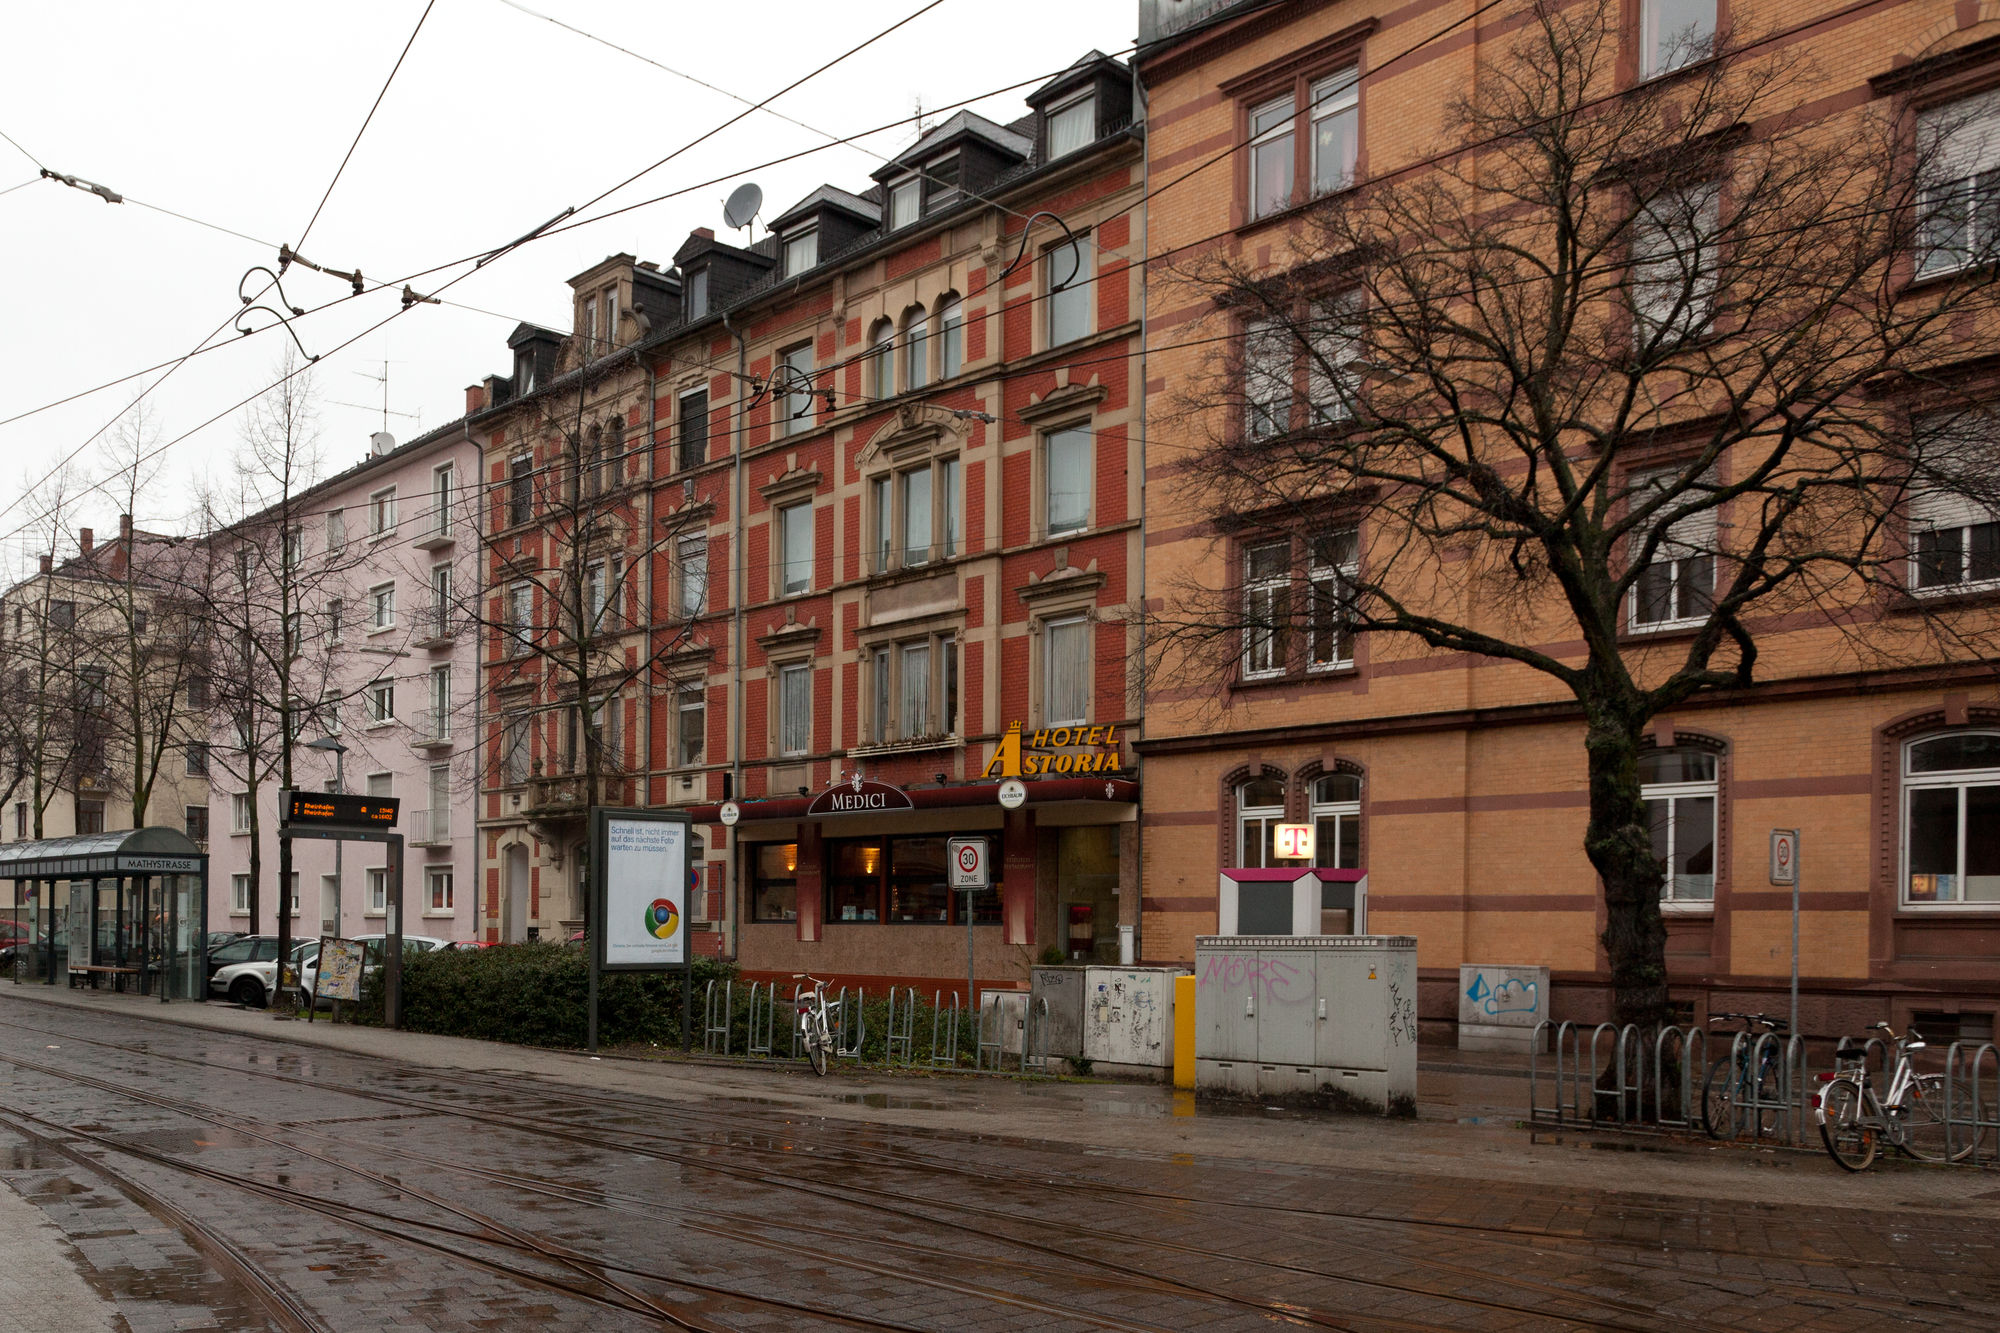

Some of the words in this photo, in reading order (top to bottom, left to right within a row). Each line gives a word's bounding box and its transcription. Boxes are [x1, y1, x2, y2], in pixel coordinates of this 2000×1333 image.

[1032, 725, 1120, 748] HOTEL
[980, 728, 1121, 778] ASTORIA
[831, 793, 887, 810] MEDICI
[304, 803, 335, 811] Rheinhafen
[303, 809, 334, 817] Rheinhafen
[611, 826, 635, 835] Schnell
[645, 828, 660, 836] nicht
[635, 836, 659, 844] nächste
[661, 837, 675, 845] Foto
[963, 853, 974, 865] 30
[128, 860, 192, 870] MATHYSTRASSE
[960, 875, 978, 883] ZONE
